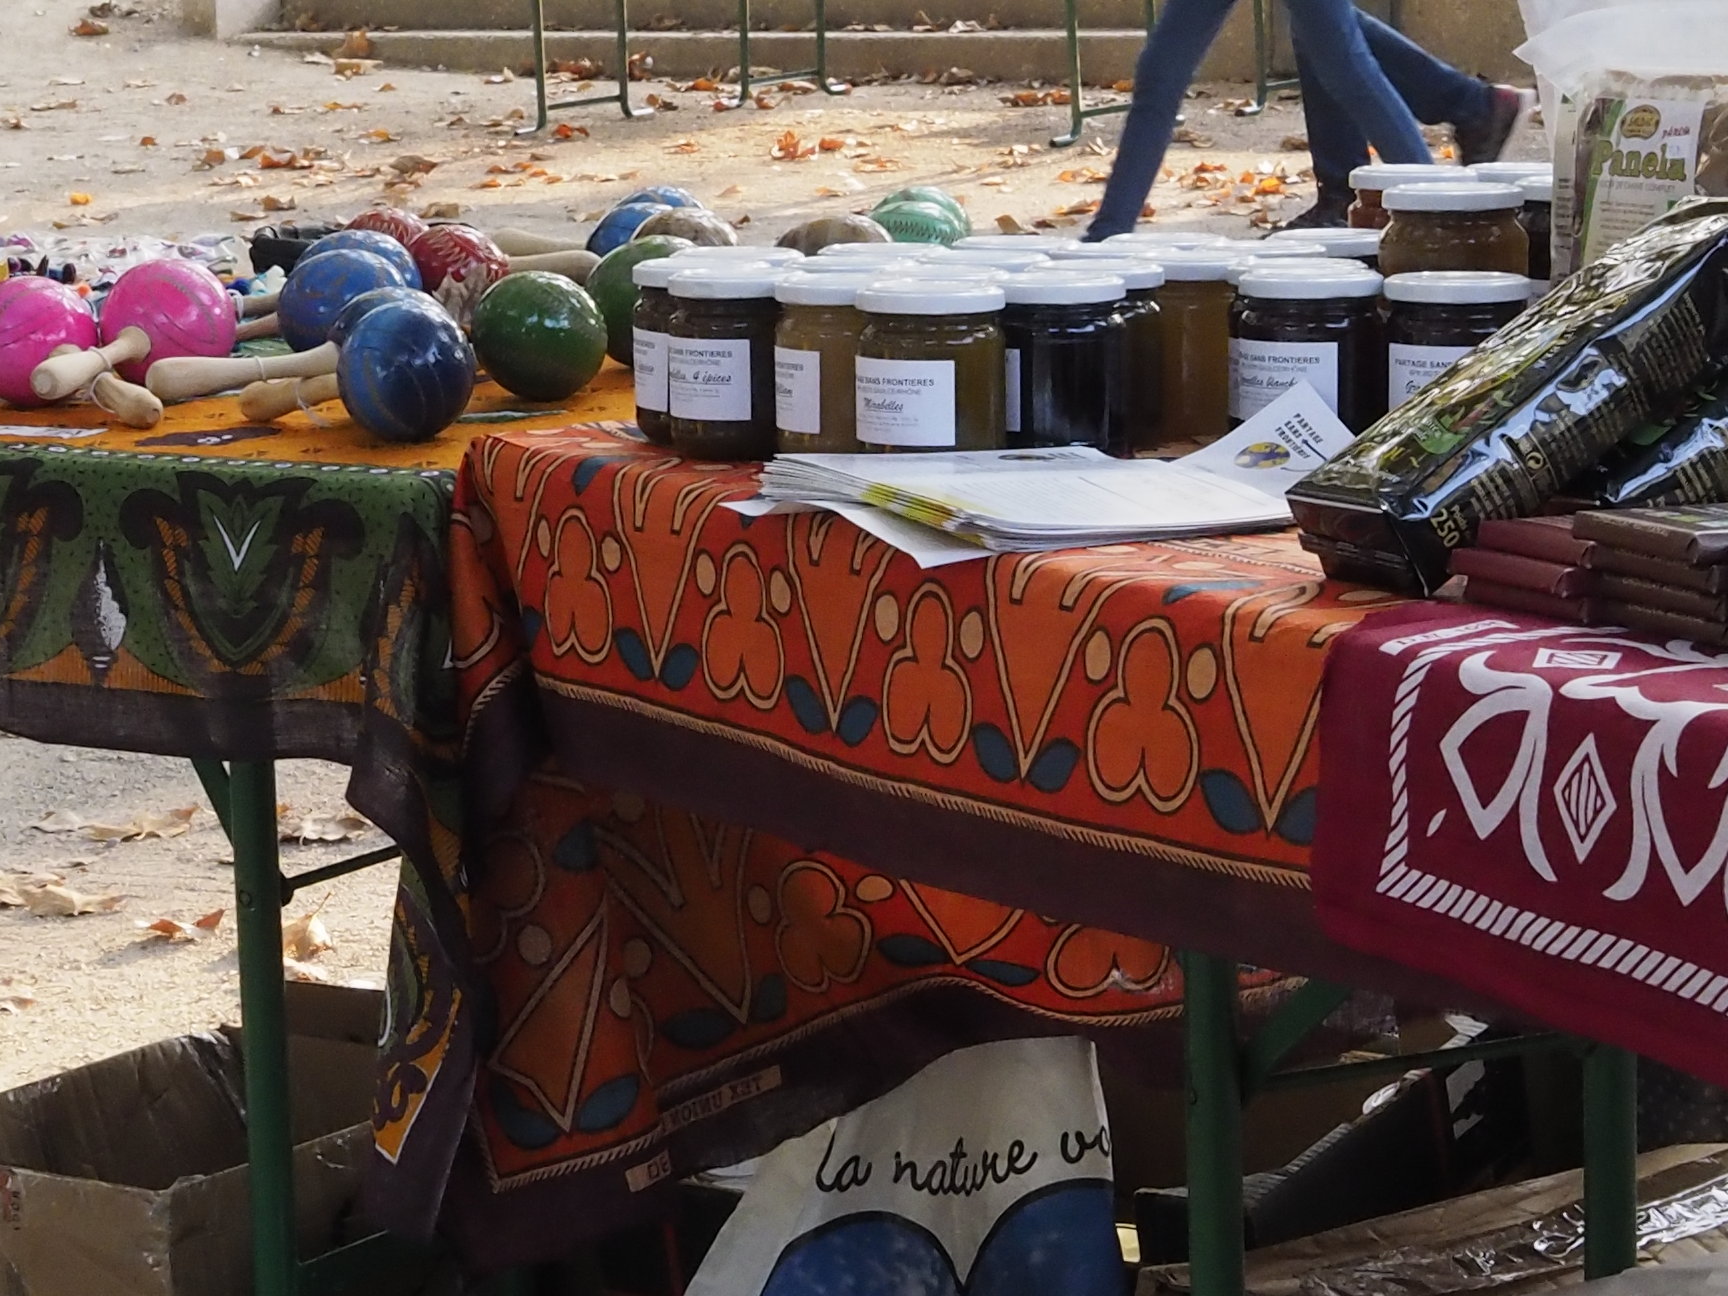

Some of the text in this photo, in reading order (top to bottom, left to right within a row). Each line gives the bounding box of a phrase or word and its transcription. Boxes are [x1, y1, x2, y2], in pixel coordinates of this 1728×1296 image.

[1592, 138, 1687, 182] Panela
[1267, 355, 1320, 365] FRONTIERES
[882, 377, 935, 387] FRONTIERES
[1291, 411, 1325, 445] PARTAGE
[1428, 507, 1461, 548] 250
[815, 1131, 873, 1195] la
[892, 1136, 1039, 1197] nature
